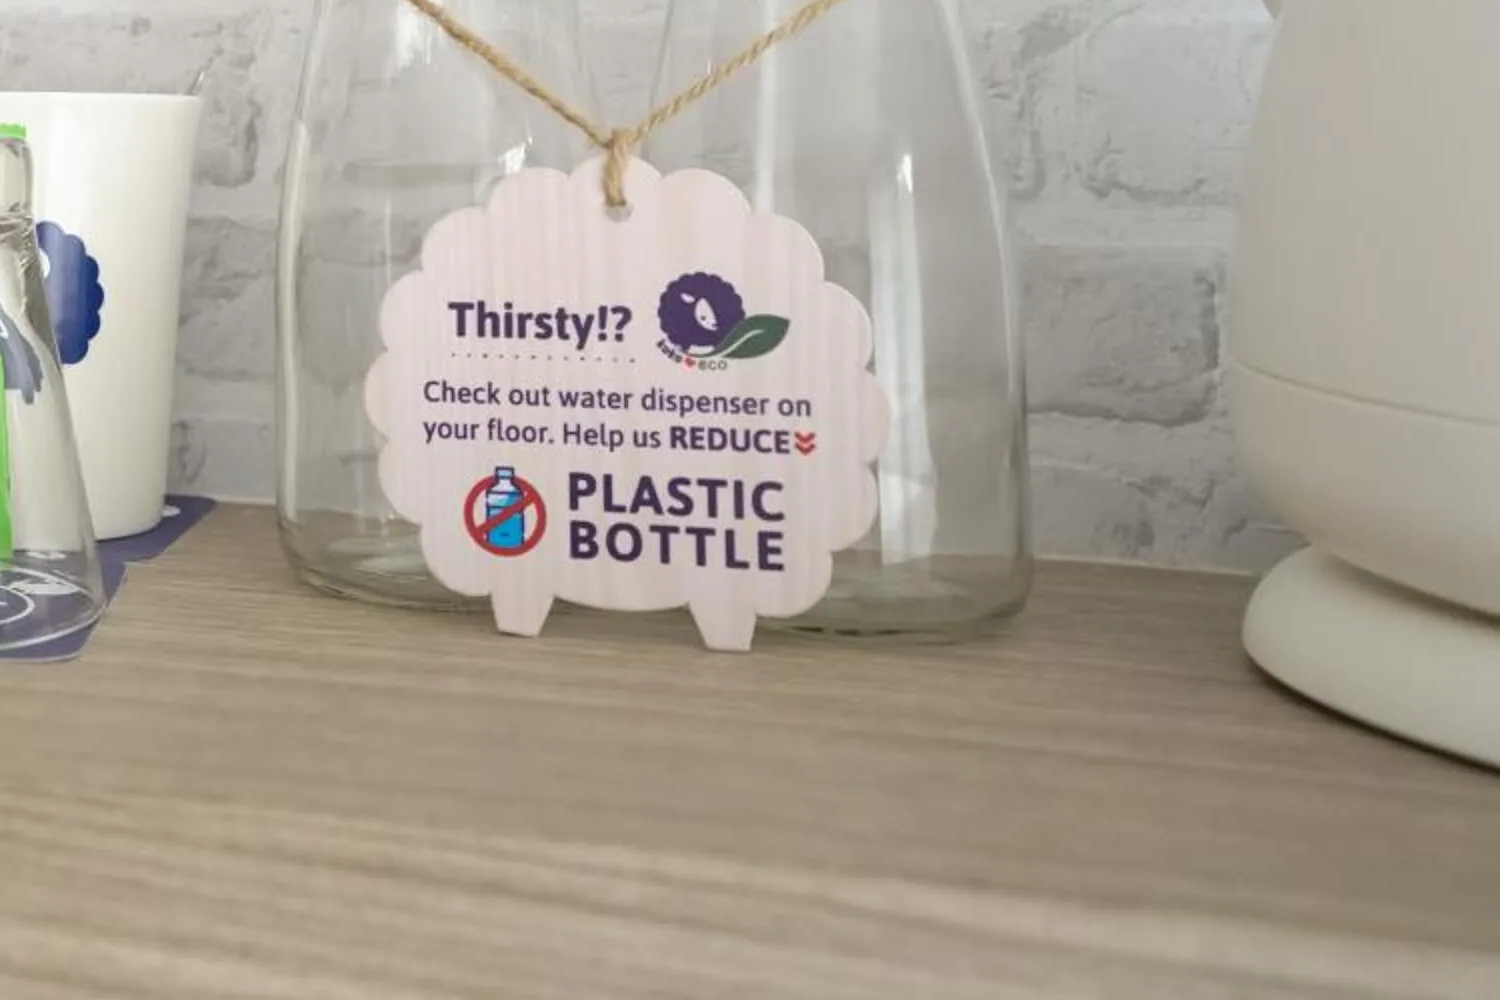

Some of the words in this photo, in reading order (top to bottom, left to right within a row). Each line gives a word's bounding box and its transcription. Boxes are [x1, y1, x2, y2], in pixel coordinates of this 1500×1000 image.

[448, 300, 633, 350] Thirsty!?
[423, 380, 501, 405] Check
[508, 387, 551, 407] out
[558, 389, 634, 410] water
[641, 387, 769, 417] dispenser
[777, 398, 812, 417] on
[423, 421, 480, 443] your
[487, 418, 554, 444] floor.
[563, 423, 624, 452] Help
[633, 430, 661, 448] us
[669, 426, 791, 455] REDUCE
[569, 471, 785, 521] PLASTIC
[569, 519, 785, 571] BOTTLE
